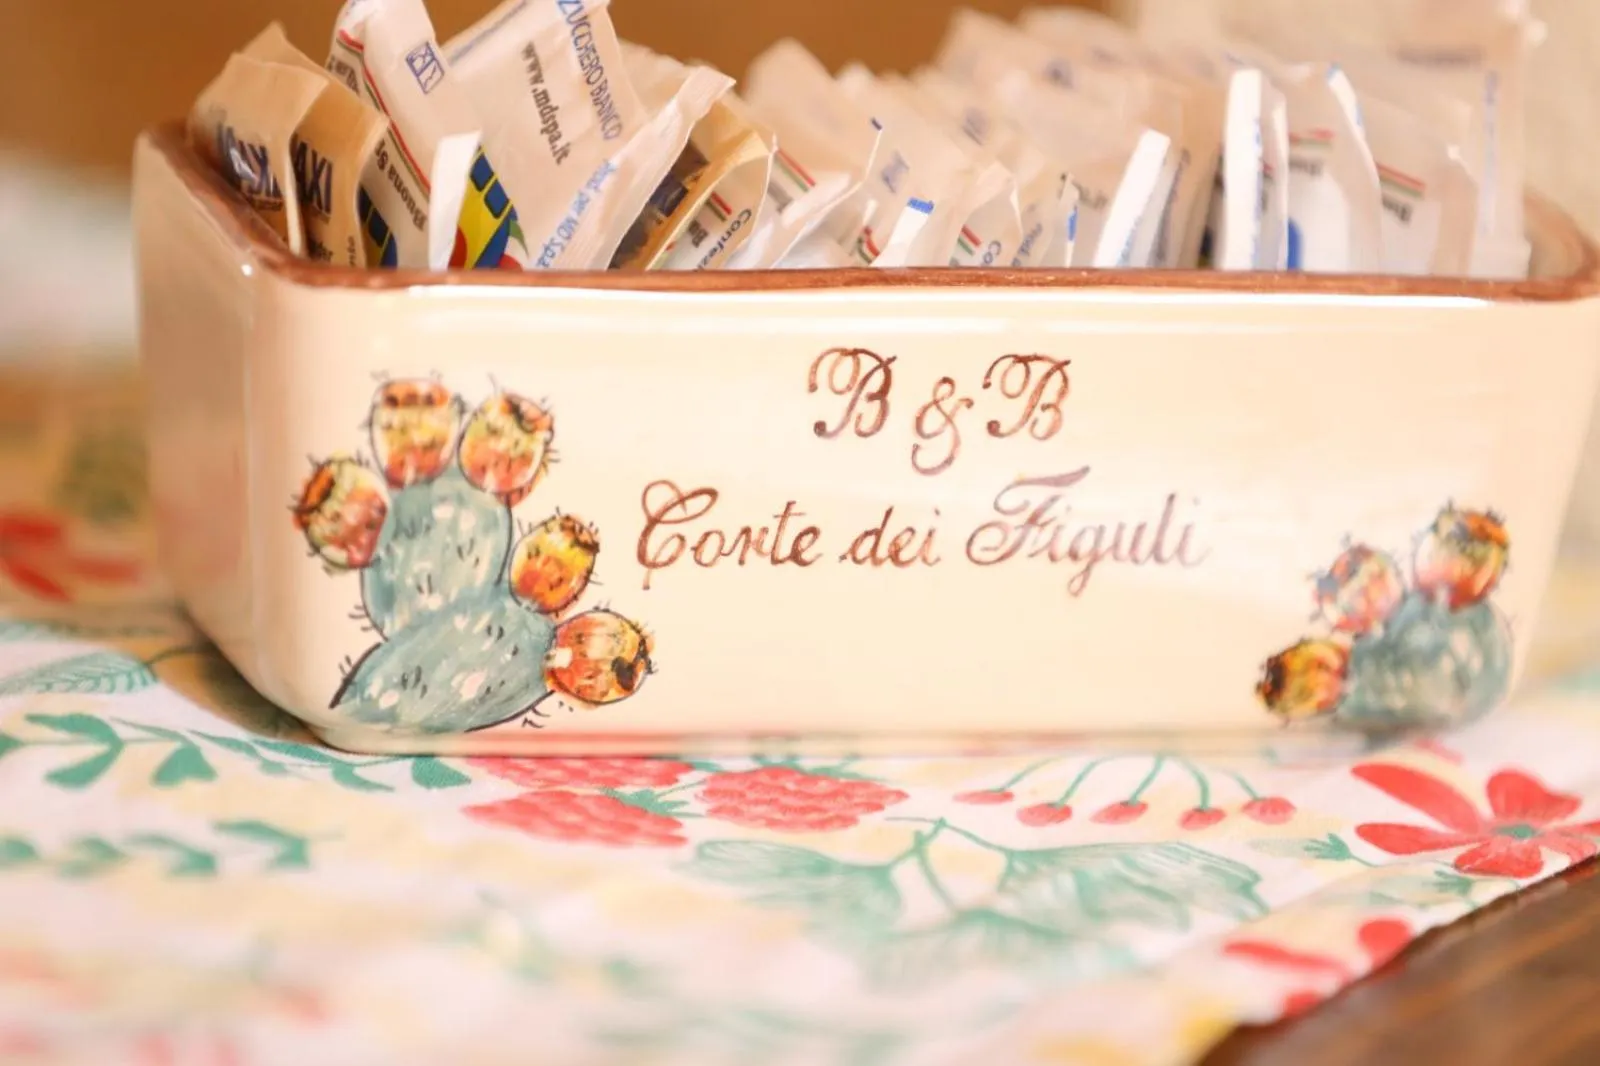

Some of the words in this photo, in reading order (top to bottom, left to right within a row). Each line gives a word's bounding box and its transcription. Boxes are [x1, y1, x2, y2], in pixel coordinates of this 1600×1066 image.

[521, 40, 571, 166] www.mdspa.it
[556, 0, 606, 86] ZUCCHERO
[590, 79, 623, 141] BIANCO
[387, 163, 428, 232] Buona
[807, 346, 897, 439] B
[911, 376, 975, 476] &
[981, 352, 1072, 441] B
[635, 479, 824, 591] Corte
[837, 506, 942, 567] dei
[965, 465, 1208, 598] Figuli
